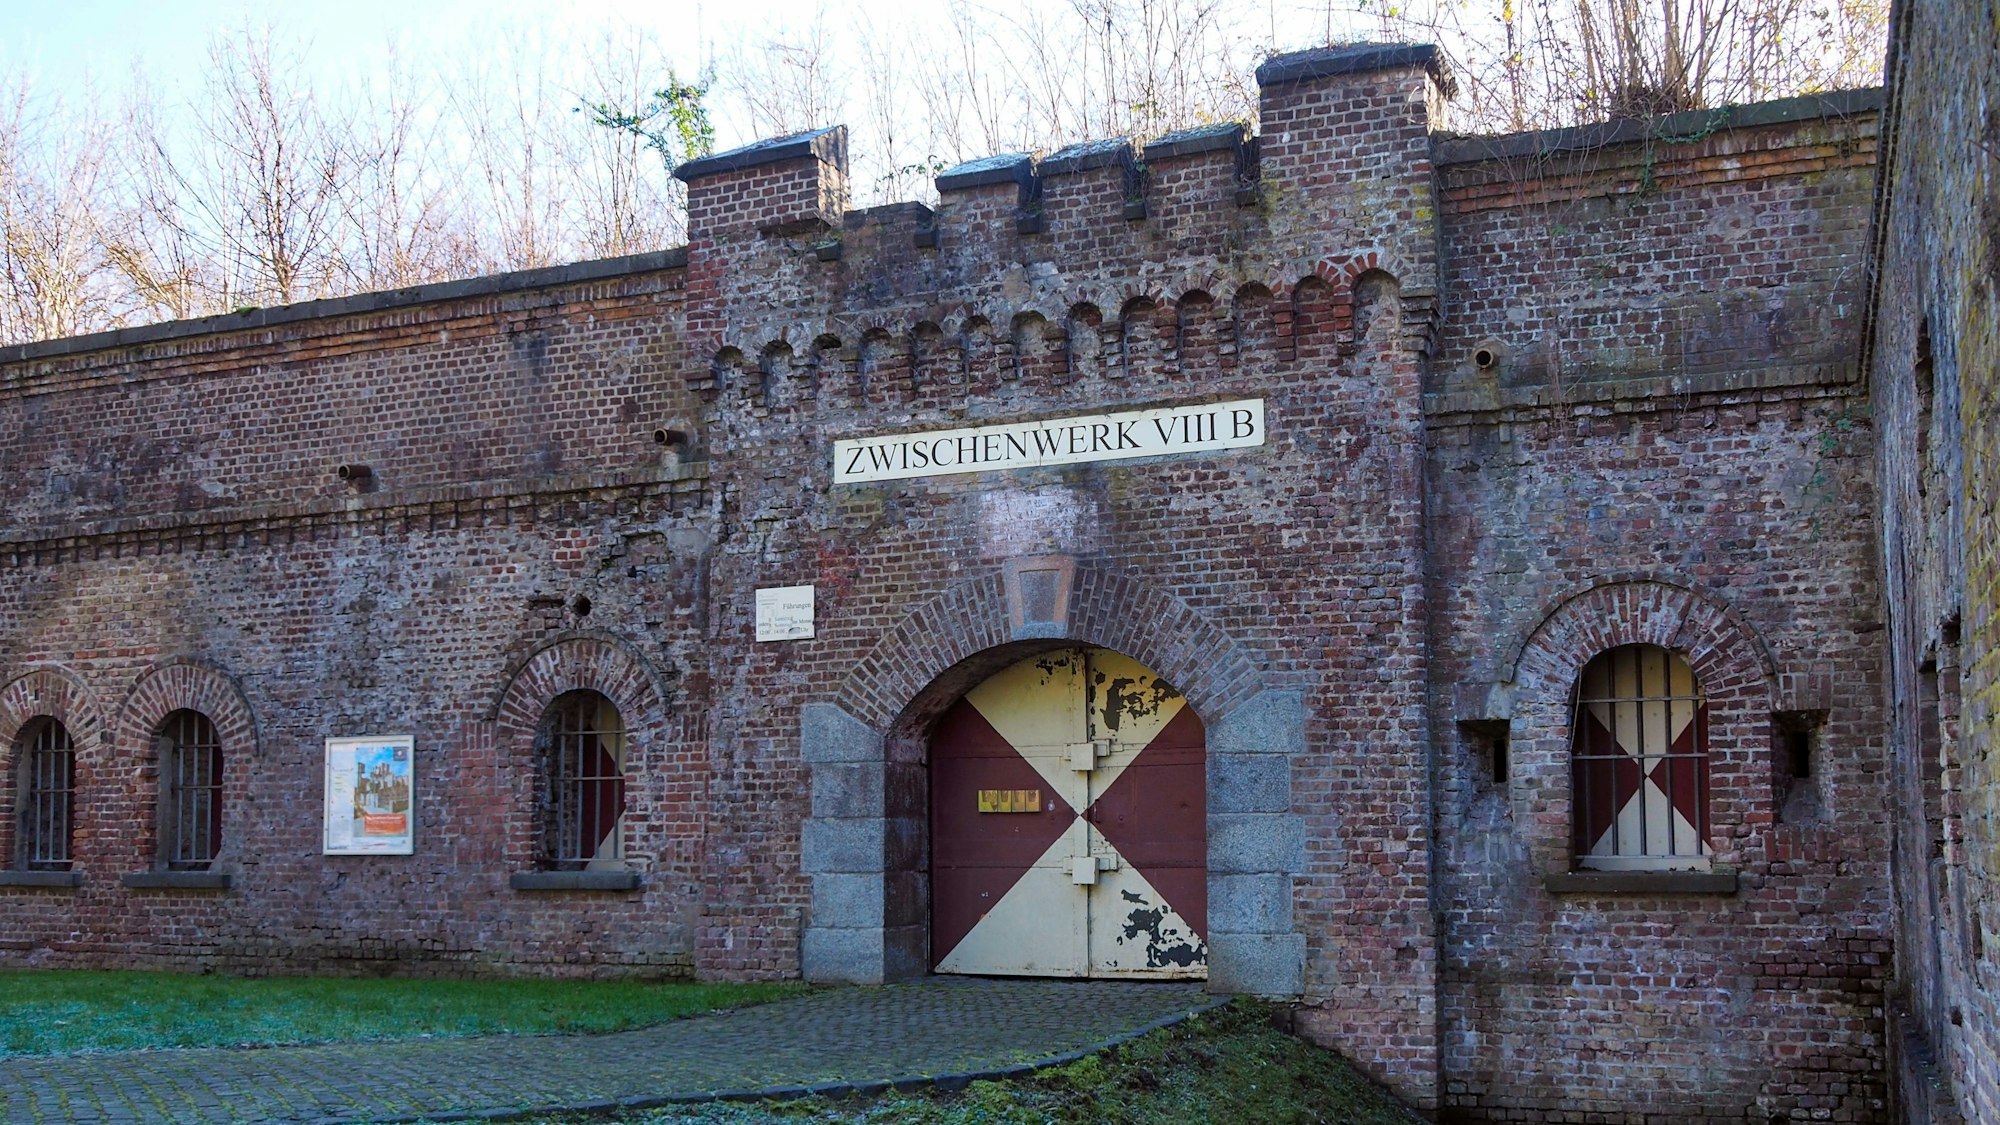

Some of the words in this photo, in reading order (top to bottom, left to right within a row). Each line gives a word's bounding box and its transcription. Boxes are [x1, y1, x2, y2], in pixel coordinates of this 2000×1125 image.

[845, 420, 1142, 475] ZWISCHENWERK
[1152, 413, 1218, 447] VIII
[1229, 409, 1255, 439] B
